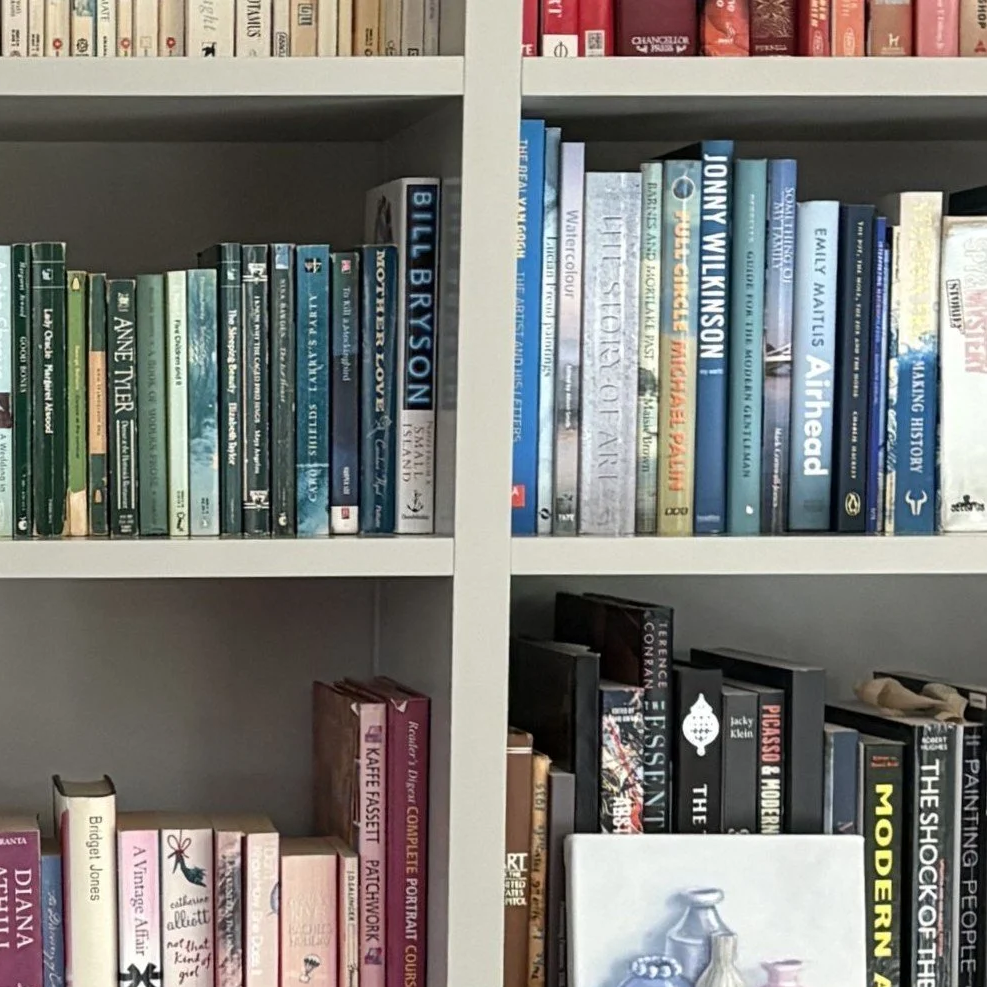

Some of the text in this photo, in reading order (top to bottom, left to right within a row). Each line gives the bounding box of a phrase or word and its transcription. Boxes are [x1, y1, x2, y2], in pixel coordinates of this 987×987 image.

[631, 36, 689, 44] CHANCELLOR
[564, 210, 579, 299] Watercolour
[700, 154, 728, 359] JONNY WILKINSON
[375, 250, 386, 413] MOTHER LOVE
[407, 190, 432, 403] BILL BRYSON
[113, 316, 135, 413] ANNE TYLER
[668, 210, 688, 492] FULL CIRCLE MICHAEL PALIN
[803, 228, 829, 475] EMILY MAITLIS Airhead
[909, 360, 925, 473] MAKING HISTORY
[644, 622, 654, 689] CONRAN
[658, 623, 668, 689] TERENCE
[405, 721, 420, 767] Reader's
[761, 705, 781, 775] PICASSO &
[405, 769, 418, 803] Digest
[920, 759, 940, 809] THE
[86, 816, 103, 902] Bridget Jones
[133, 846, 146, 857] A
[365, 747, 380, 942] KAFFE FASSETT PATCHWORK
[406, 806, 418, 874] COMPLETE
[874, 784, 894, 957] MODERN
[918, 813, 939, 901] SHOCK
[14, 869, 32, 949] DIANA
[131, 860, 147, 914] Vintage
[405, 878, 418, 941] PORTRAIT
[917, 905, 938, 938] OF
[134, 917, 149, 957] Affair
